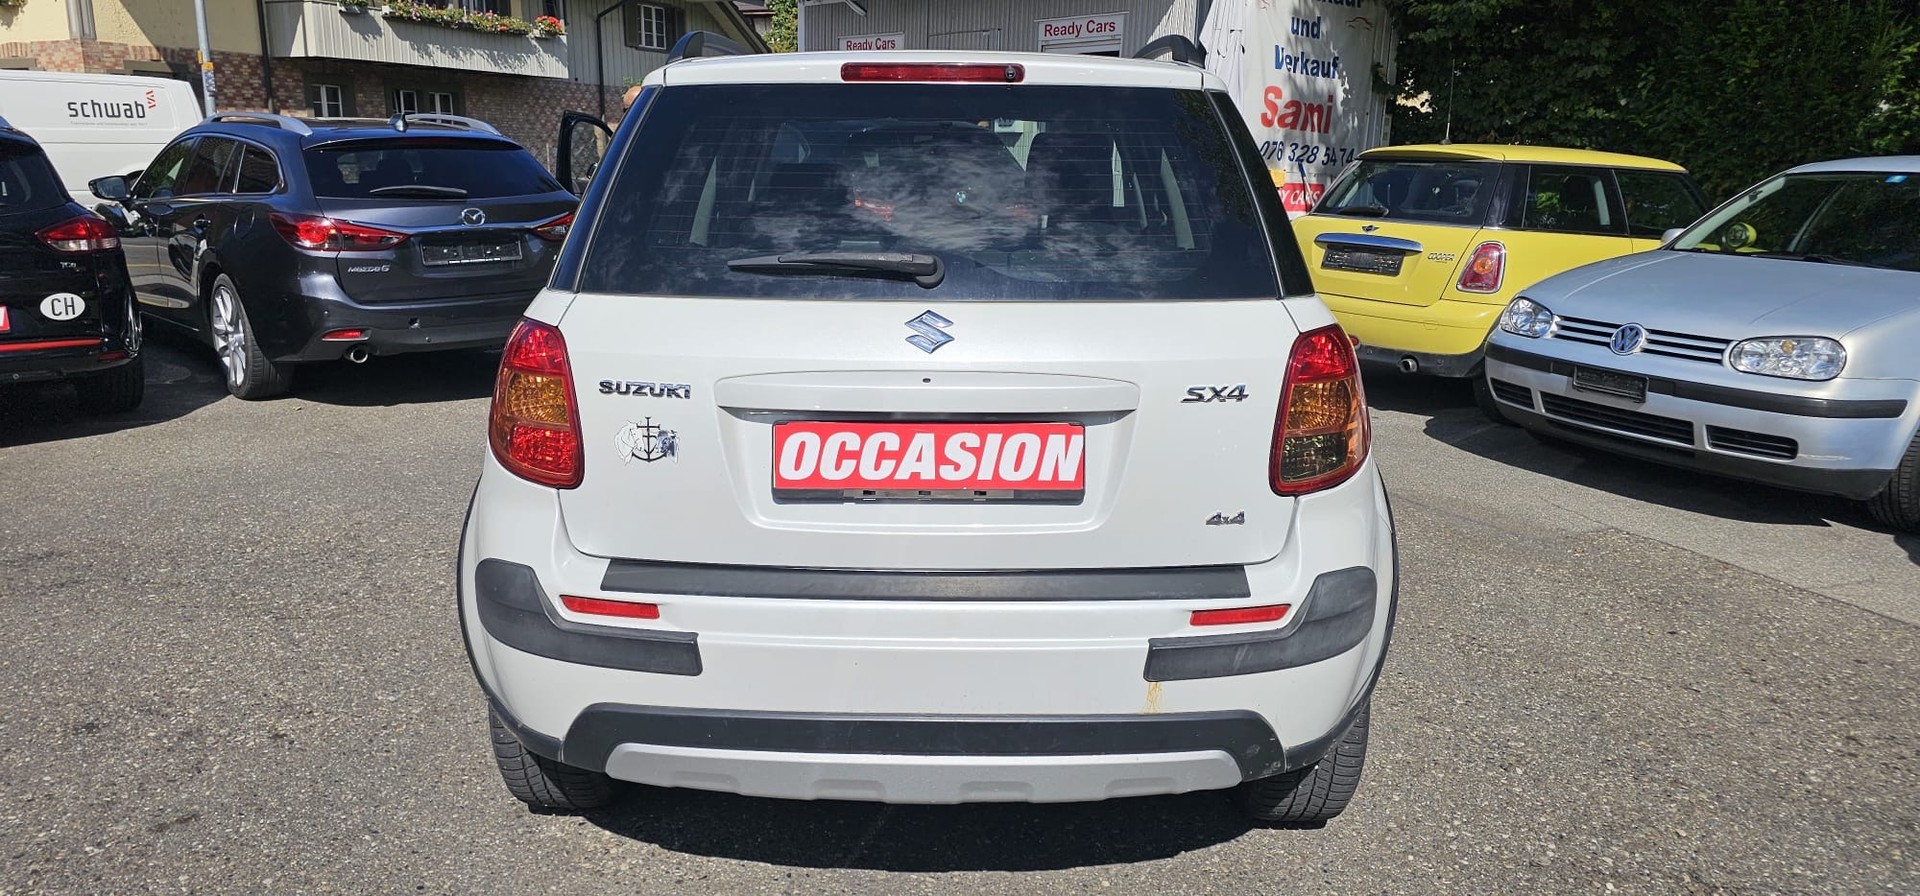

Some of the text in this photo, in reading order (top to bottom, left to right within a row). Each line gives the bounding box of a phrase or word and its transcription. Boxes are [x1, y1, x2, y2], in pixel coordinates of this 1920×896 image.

[1044, 19, 1116, 38] Ready Cars
[1291, 16, 1321, 39] und
[846, 37, 896, 51] Ready Cars
[1274, 45, 1339, 79] Verkauf
[67, 100, 146, 118] schwab
[1260, 85, 1334, 134] Sami
[1260, 140, 1284, 161] 076
[1287, 142, 1320, 164] 328
[51, 297, 76, 316] CH
[599, 380, 691, 399] SUZUKI
[1179, 384, 1249, 403] SX4
[778, 431, 1084, 483] OCCASION
